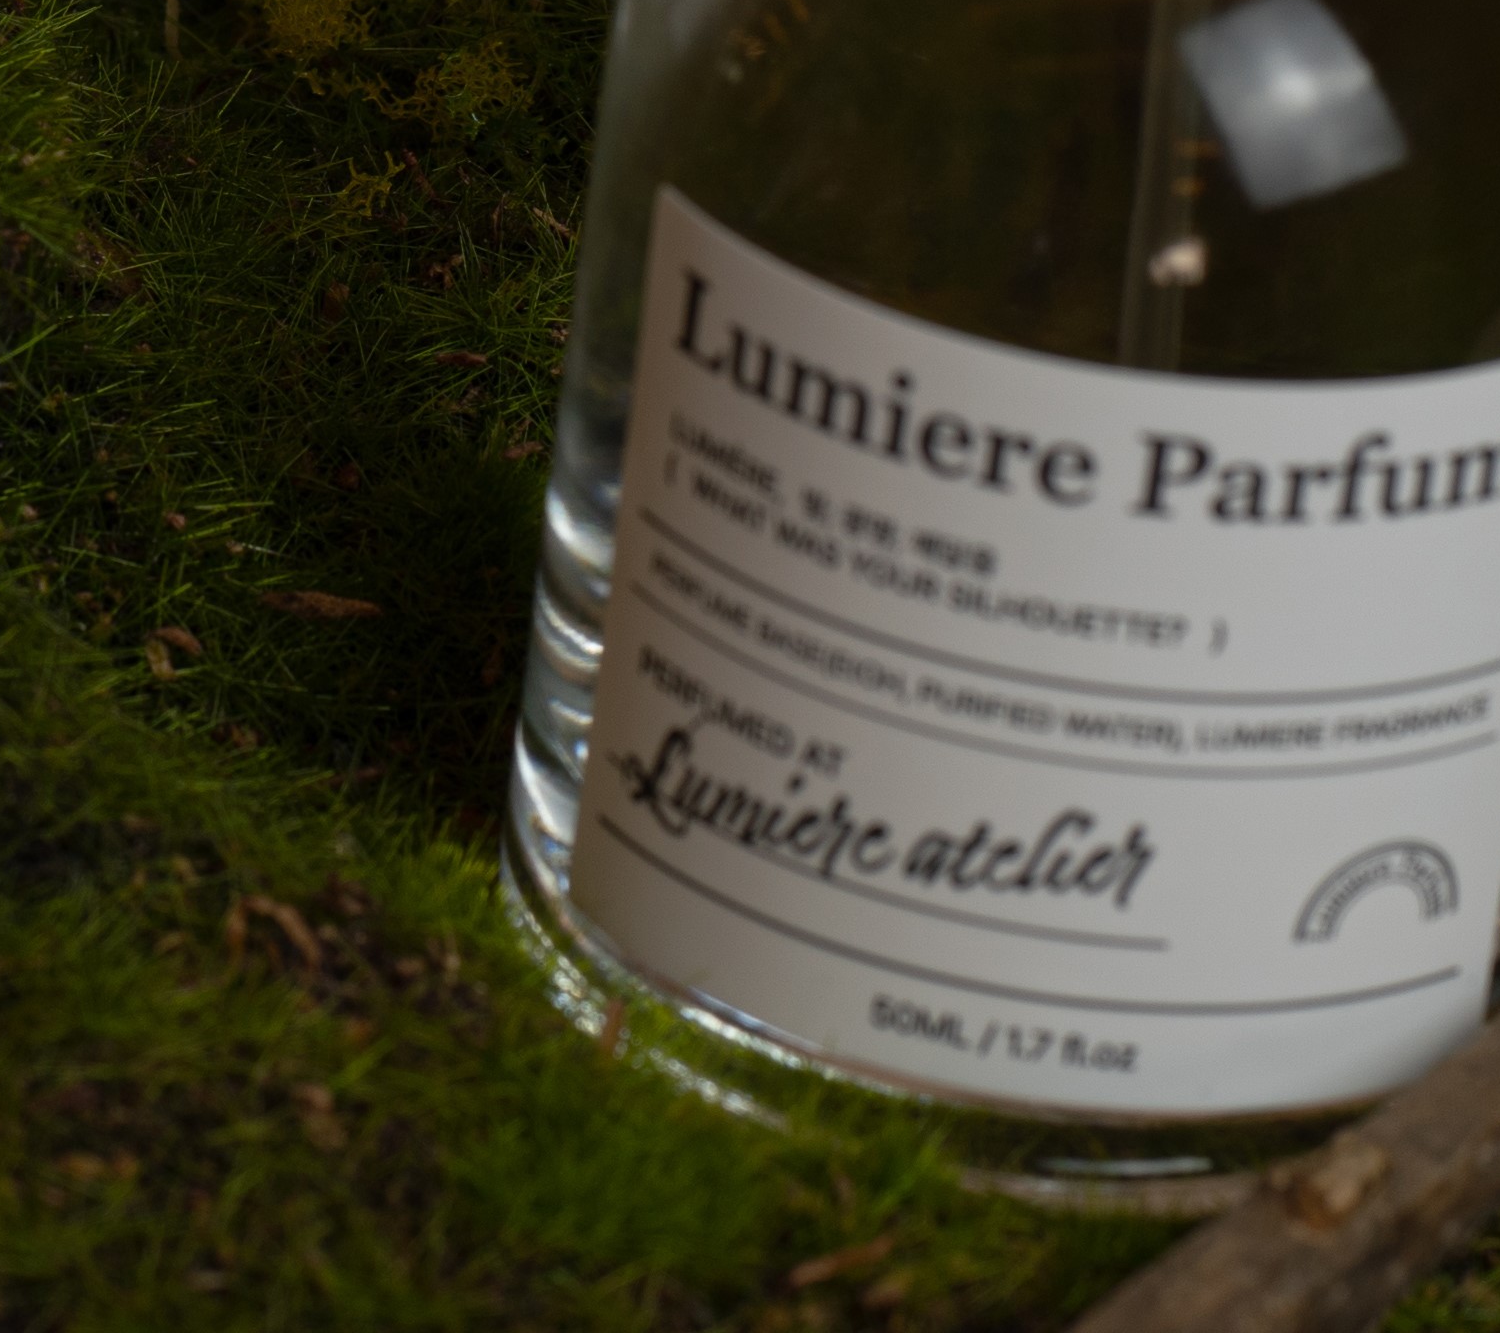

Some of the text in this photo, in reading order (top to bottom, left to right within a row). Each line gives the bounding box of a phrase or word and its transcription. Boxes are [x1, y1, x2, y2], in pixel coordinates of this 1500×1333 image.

[676, 265, 1098, 509] Lumiere
[850, 546, 940, 601] YOUR
[638, 644, 848, 776] PERFUMED AT
[905, 807, 1154, 910] atelier
[869, 992, 971, 1049] 50ML
